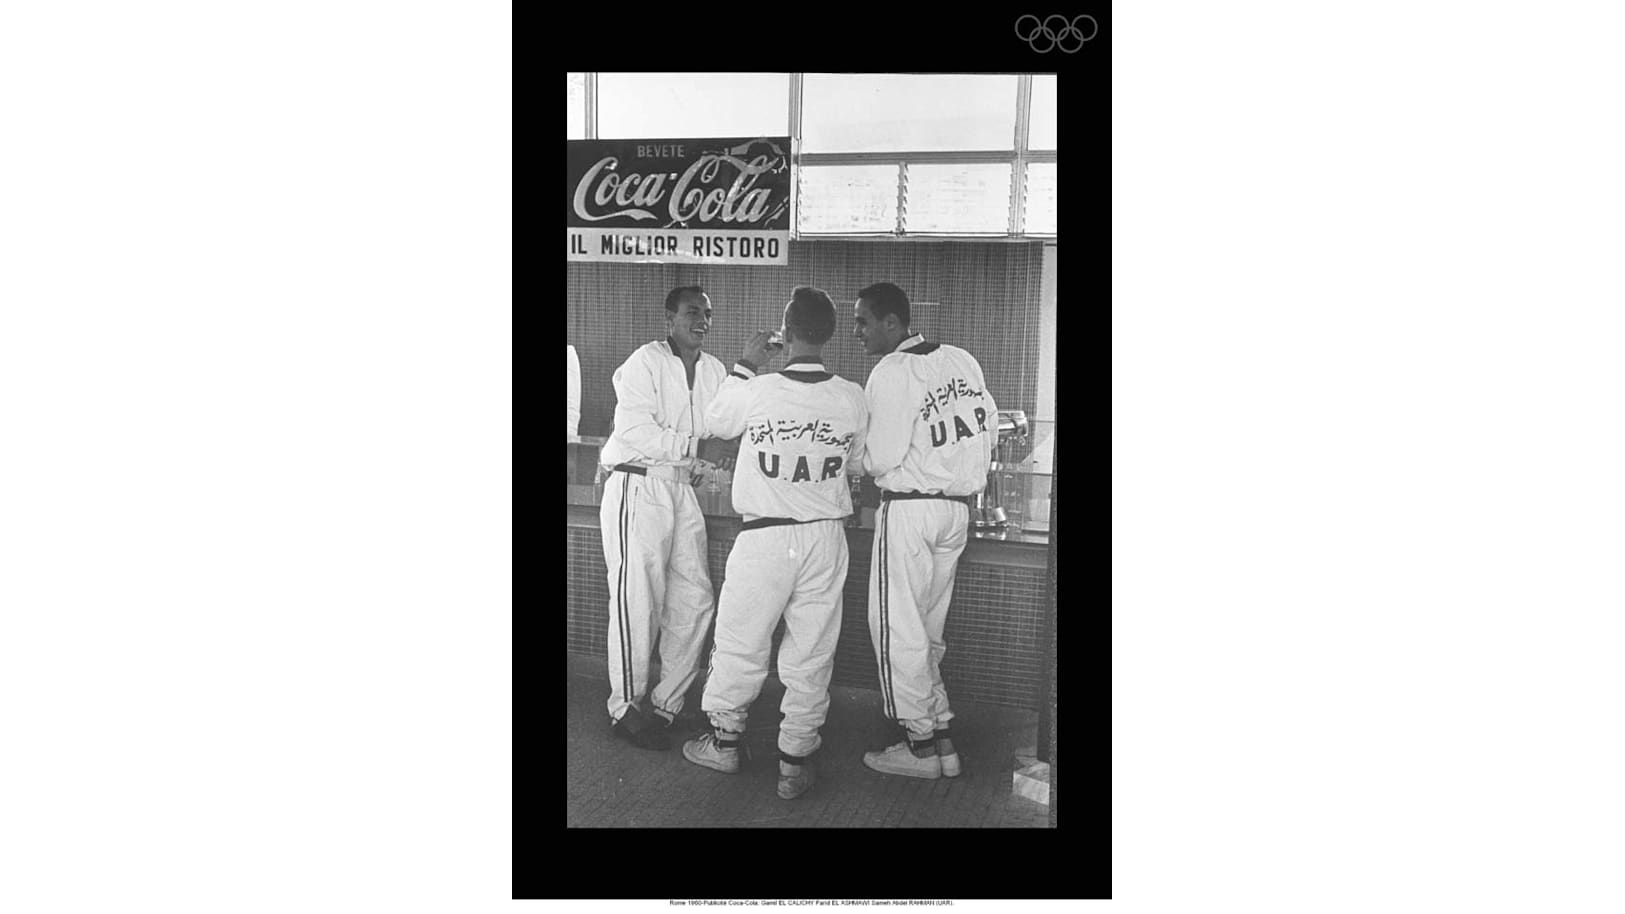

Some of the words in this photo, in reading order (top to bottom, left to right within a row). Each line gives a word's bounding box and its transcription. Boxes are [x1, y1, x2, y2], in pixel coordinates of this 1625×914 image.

[637, 145, 685, 158] BEVETE
[571, 234, 587, 255] IL
[601, 235, 678, 256] MIGLIOR
[693, 236, 780, 258] RISTORO
